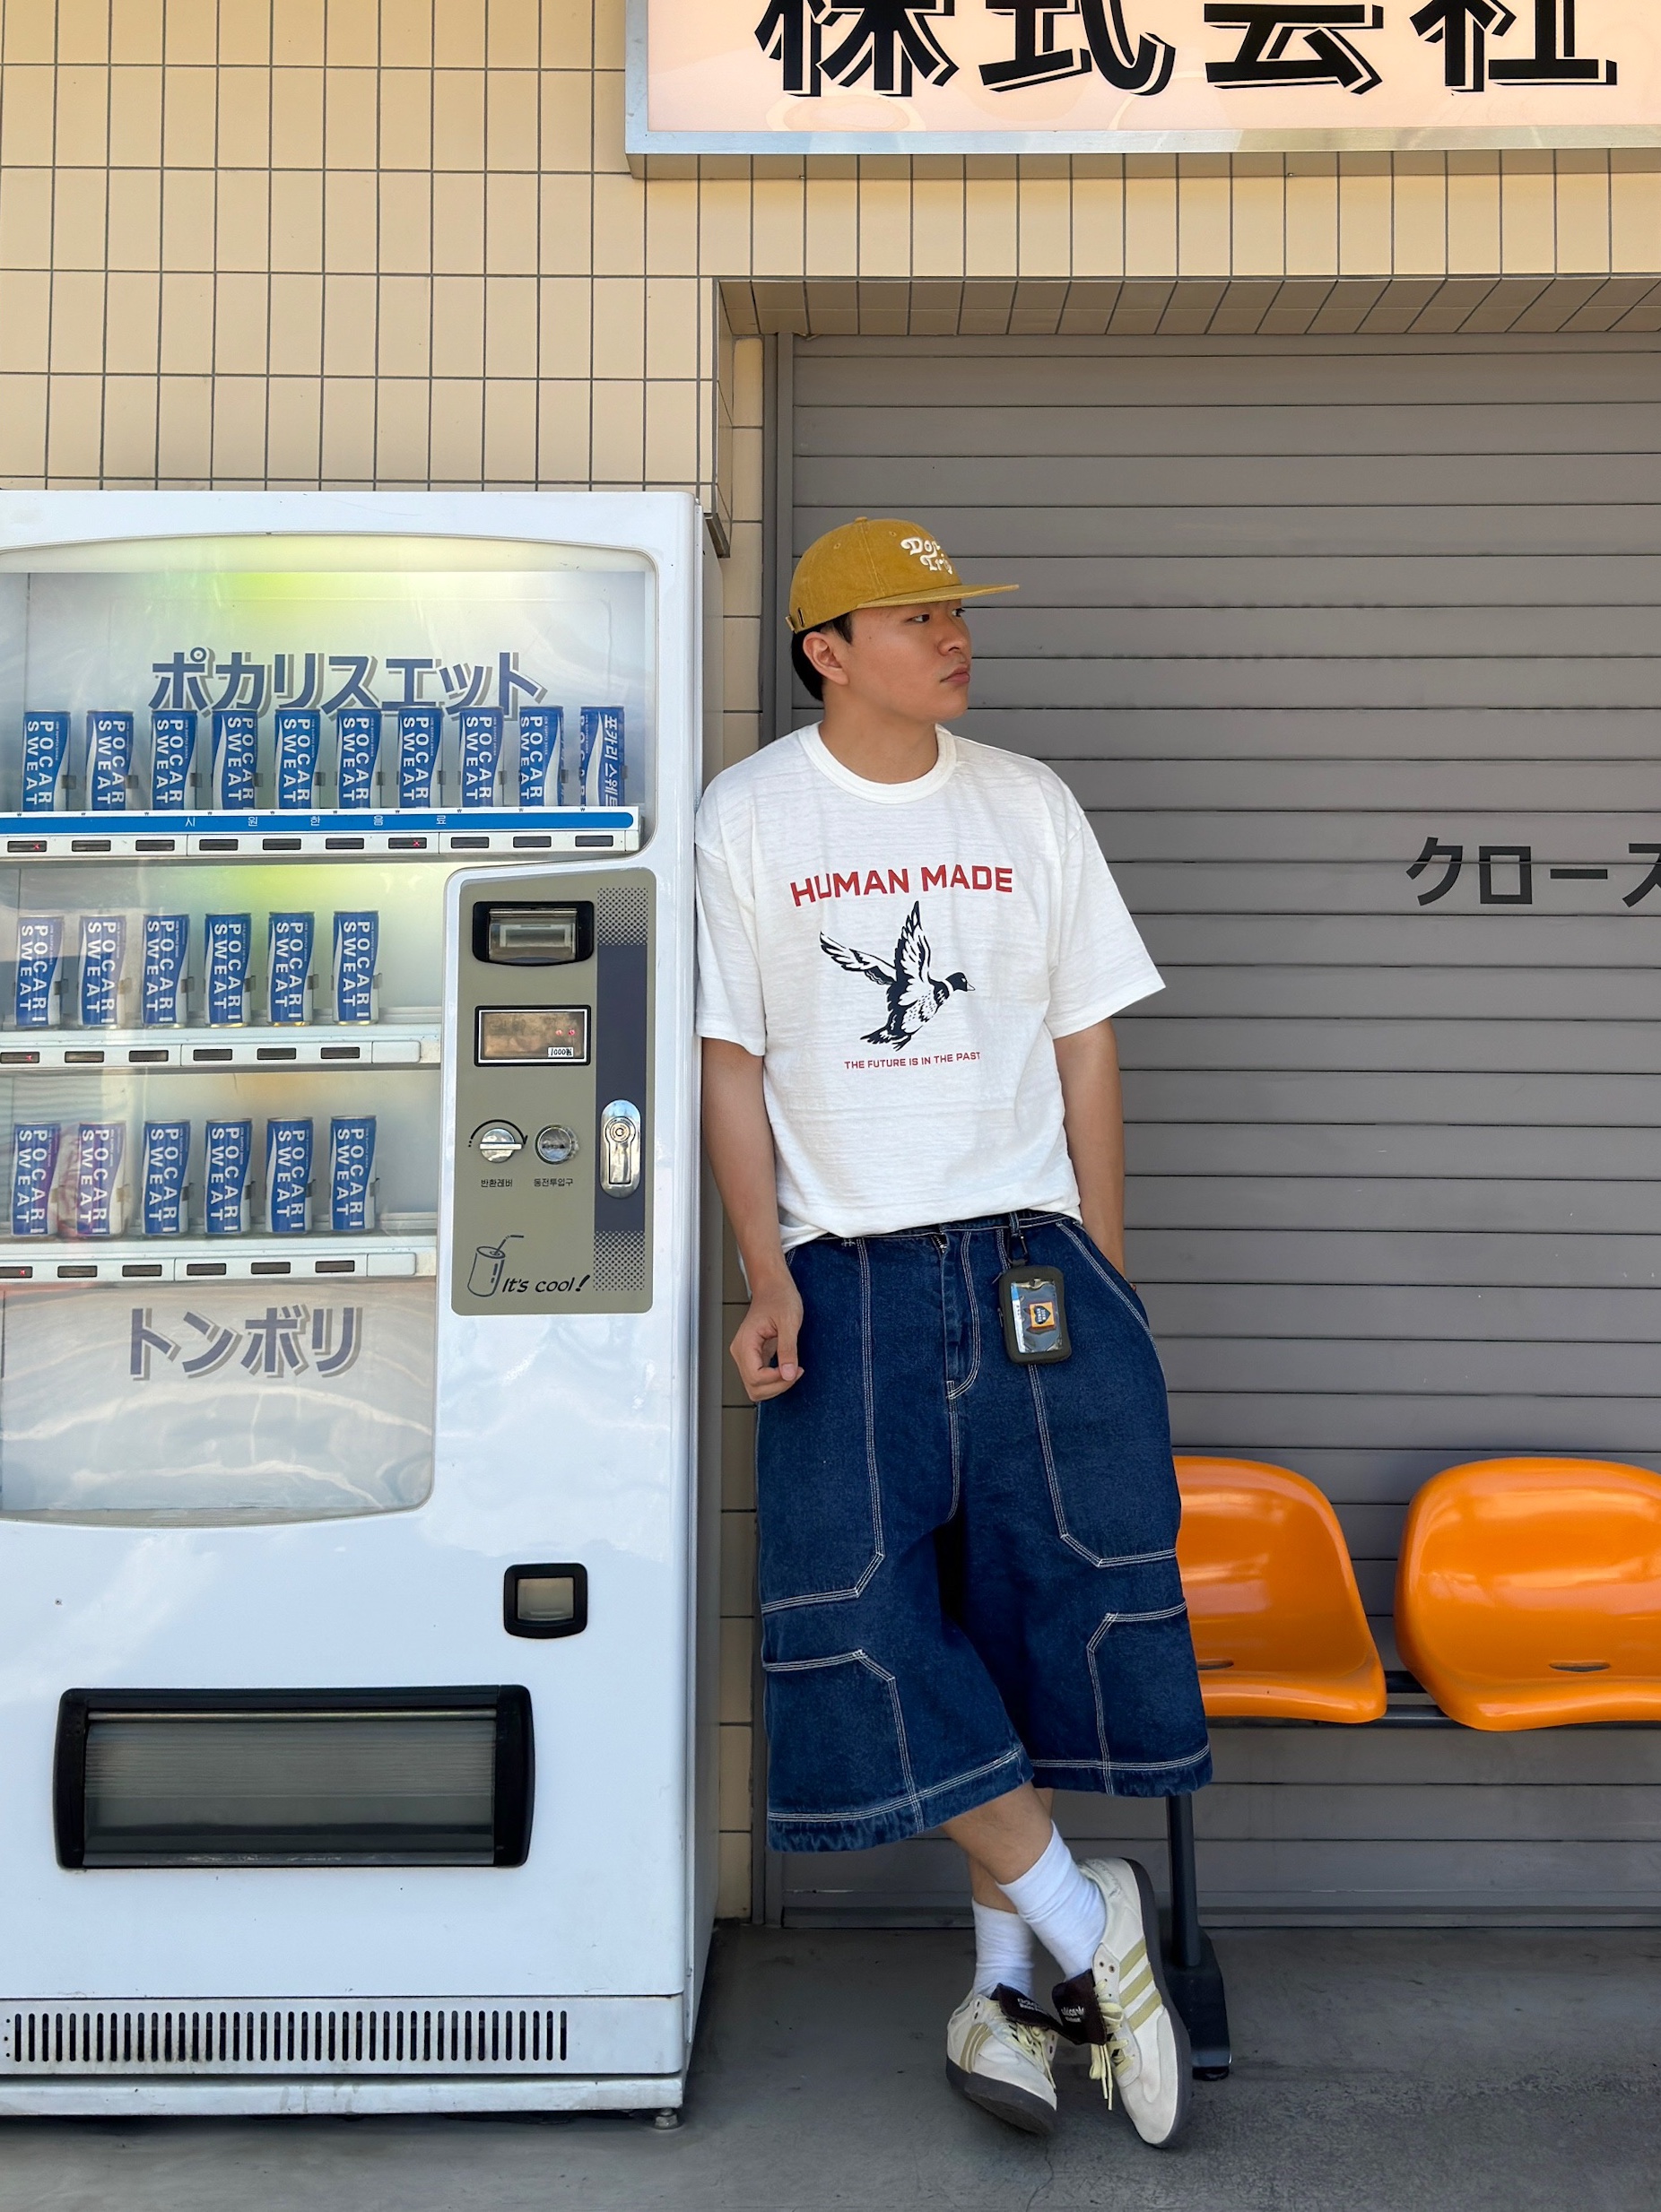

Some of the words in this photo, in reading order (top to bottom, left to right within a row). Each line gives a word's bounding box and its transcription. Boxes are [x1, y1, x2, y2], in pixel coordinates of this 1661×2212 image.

[26, 721, 39, 804] SWEAT
[98, 720, 111, 804] SWEAT
[156, 719, 169, 803] SWEAT
[228, 717, 242, 802] SWEAT
[283, 719, 297, 802] SWEAT
[343, 718, 355, 802] SWEAT
[404, 717, 416, 800] SWEAT
[466, 716, 479, 800] SWEAT
[520, 716, 529, 800] SWEAT
[604, 715, 618, 761] 포카리
[790, 868, 909, 906] HUMAN
[920, 863, 1013, 893] MADE
[20, 925, 32, 1011] SWEAT
[32, 925, 48, 1021] POCARI
[86, 922, 102, 1013] SWEAT
[101, 922, 117, 1023] POCARI
[146, 921, 160, 1011] SWEAT
[159, 921, 174, 1022] POCARI
[213, 924, 228, 1009] SWEAT
[228, 924, 241, 1019] POCARI
[274, 922, 289, 1007] SWEAT
[289, 922, 303, 1019] POCARI
[343, 922, 357, 1006] SWEAT
[357, 922, 370, 1017] POCARI
[844, 1061, 865, 1070] THE
[867, 1058, 907, 1069] FUTURE
[909, 1057, 918, 1066] IS
[921, 1056, 932, 1065] IN
[934, 1054, 953, 1064] THE
[956, 1052, 980, 1063] PAST
[16, 1130, 32, 1223] SWEAT
[30, 1130, 48, 1234] POCARI
[80, 1130, 94, 1223] SWEAT
[92, 1130, 109, 1234] POCARI
[149, 1129, 163, 1221] SWEAT
[162, 1128, 179, 1232] POCARI
[210, 1128, 224, 1221] SWEAT
[224, 1128, 239, 1231] POCARI
[276, 1130, 291, 1218] SWEAT
[291, 1130, 305, 1228] POCARI
[336, 1129, 350, 1216] SWEAT
[350, 1128, 364, 1227] POCARI
[534, 1177, 574, 1187] 동전투입구
[502, 1278, 529, 1293] It's
[535, 1274, 590, 1292] cool!
[130, 1304, 362, 1381] トンボリ
